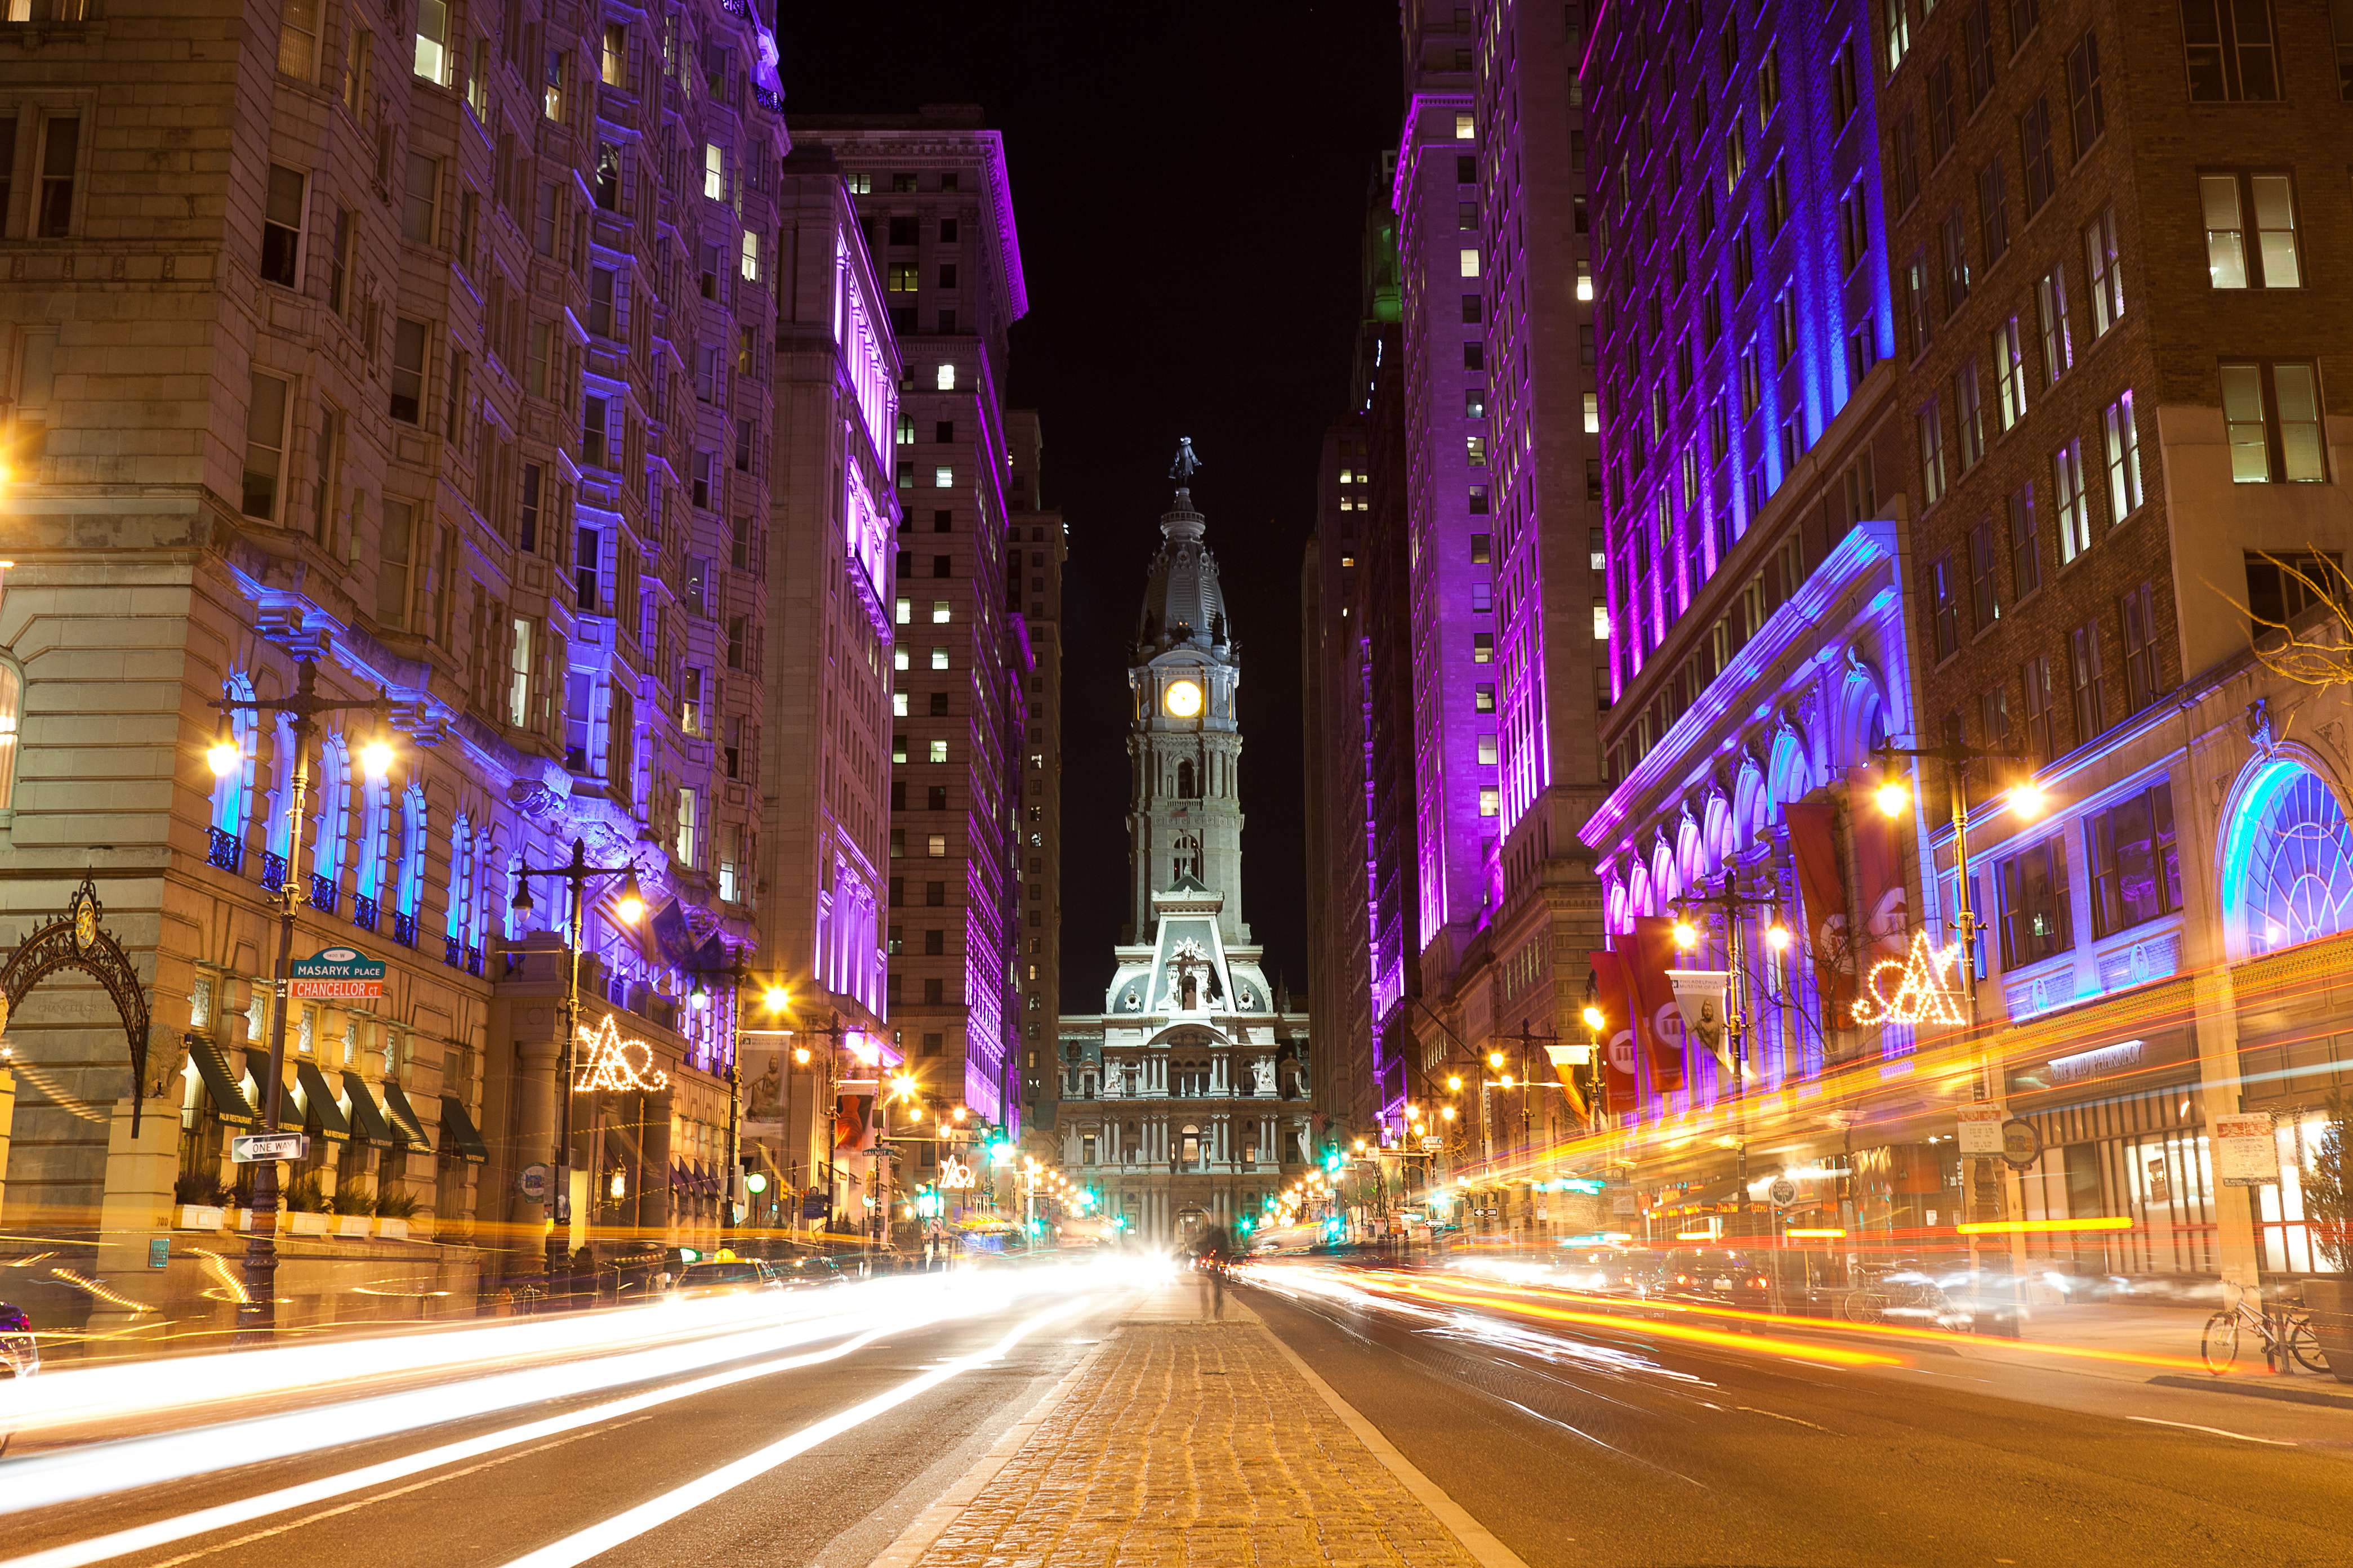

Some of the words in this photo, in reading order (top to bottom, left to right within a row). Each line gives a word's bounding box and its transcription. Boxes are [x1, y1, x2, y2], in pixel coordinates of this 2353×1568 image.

[297, 966, 350, 976] MASARYK
[297, 982, 366, 997] CHANCELLOR
[368, 987, 378, 996] CT
[2051, 1062, 2070, 1080] RITE
[2074, 1057, 2089, 1076] AID
[2094, 1044, 2143, 1071] PHARMACY
[219, 1112, 229, 1122] PALM
[229, 1114, 253, 1125] RESTAURANT
[283, 1123, 304, 1132] RESTAURANT
[253, 1143, 271, 1153] ONE
[275, 1141, 293, 1151] WAY
[1715, 1202, 1739, 1213] Italia
[1750, 1202, 1767, 1213] istro
[157, 1217, 168, 1226] 200
